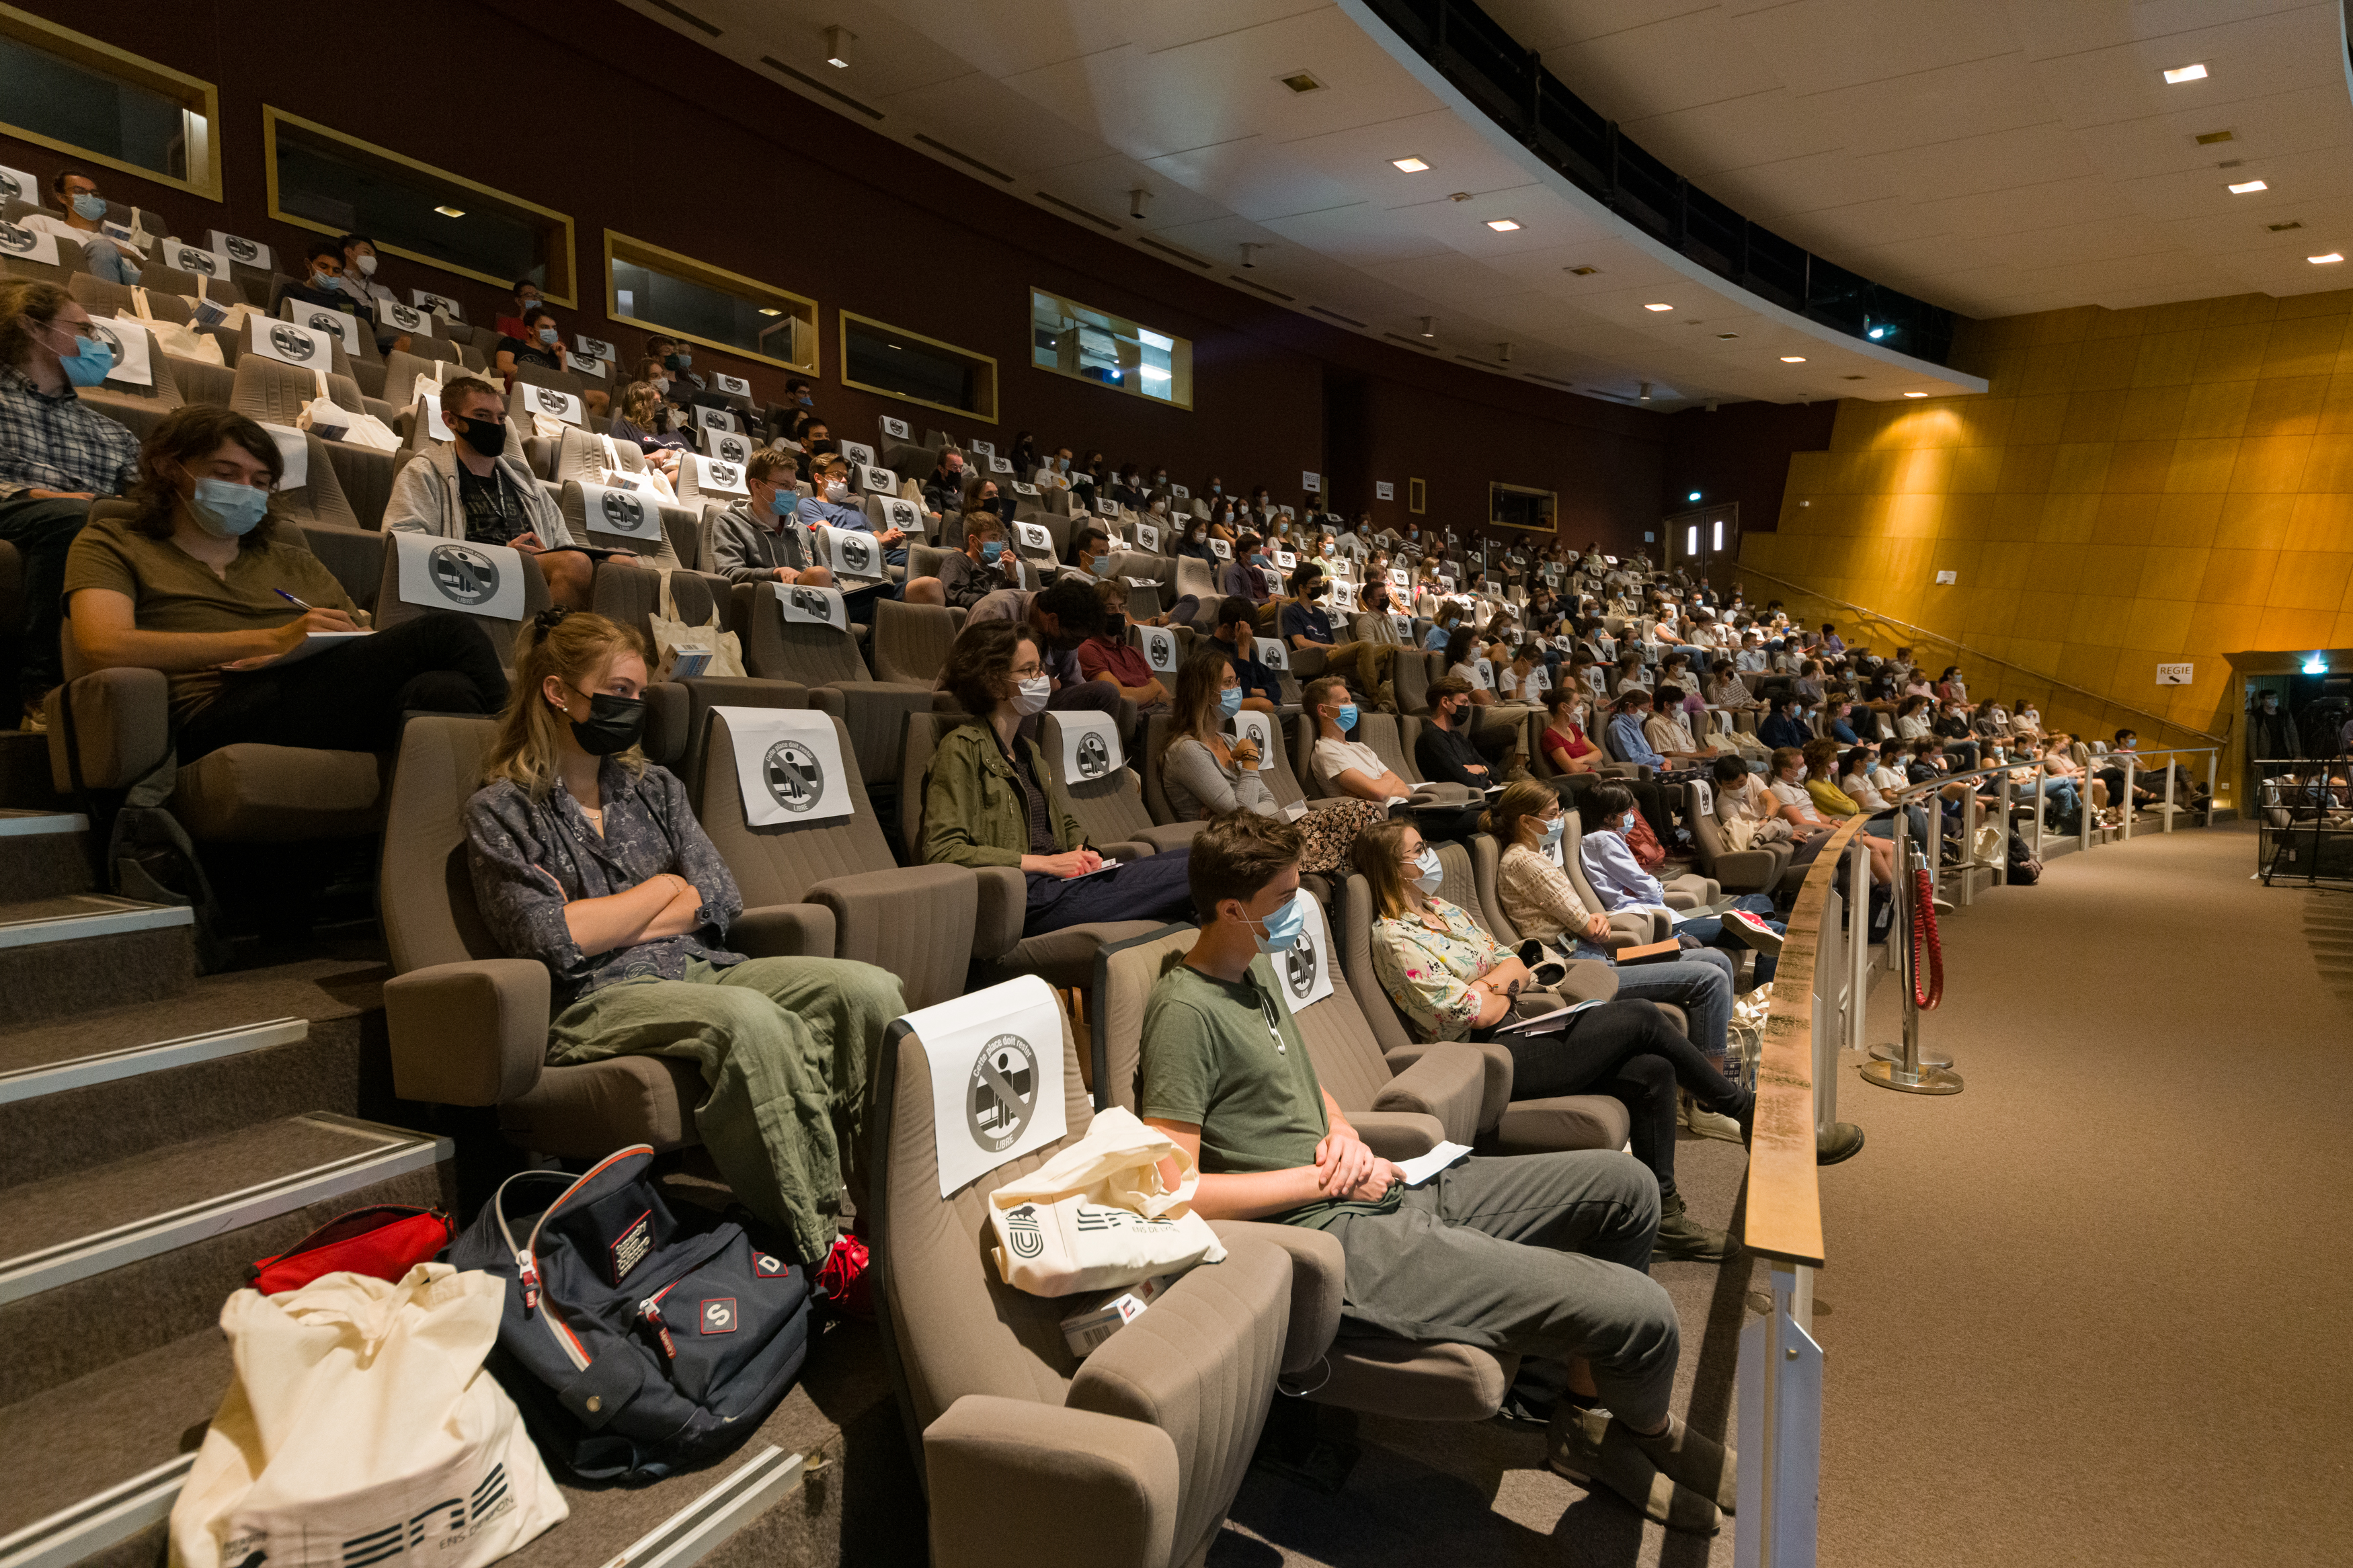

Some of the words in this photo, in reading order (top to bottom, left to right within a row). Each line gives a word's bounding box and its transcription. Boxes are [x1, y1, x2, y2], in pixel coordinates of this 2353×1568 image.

[1304, 474, 1320, 484] REGIE
[1378, 484, 1393, 492] REGIE
[434, 544, 446, 554] Cette
[472, 550, 491, 564] rester
[456, 596, 475, 604] LIBRE
[2160, 666, 2191, 675] REGIE
[765, 749, 776, 761] Cette
[774, 742, 788, 751] place
[799, 745, 813, 759] rester
[973, 1055, 988, 1077] Cette
[986, 1038, 1002, 1057] place
[1002, 1036, 1016, 1046] doit
[1016, 1039, 1032, 1058] rester
[995, 1134, 1014, 1151] LIBRE
[758, 1255, 781, 1273] D
[707, 1304, 730, 1325] S
[439, 1532, 465, 1550] ENS
